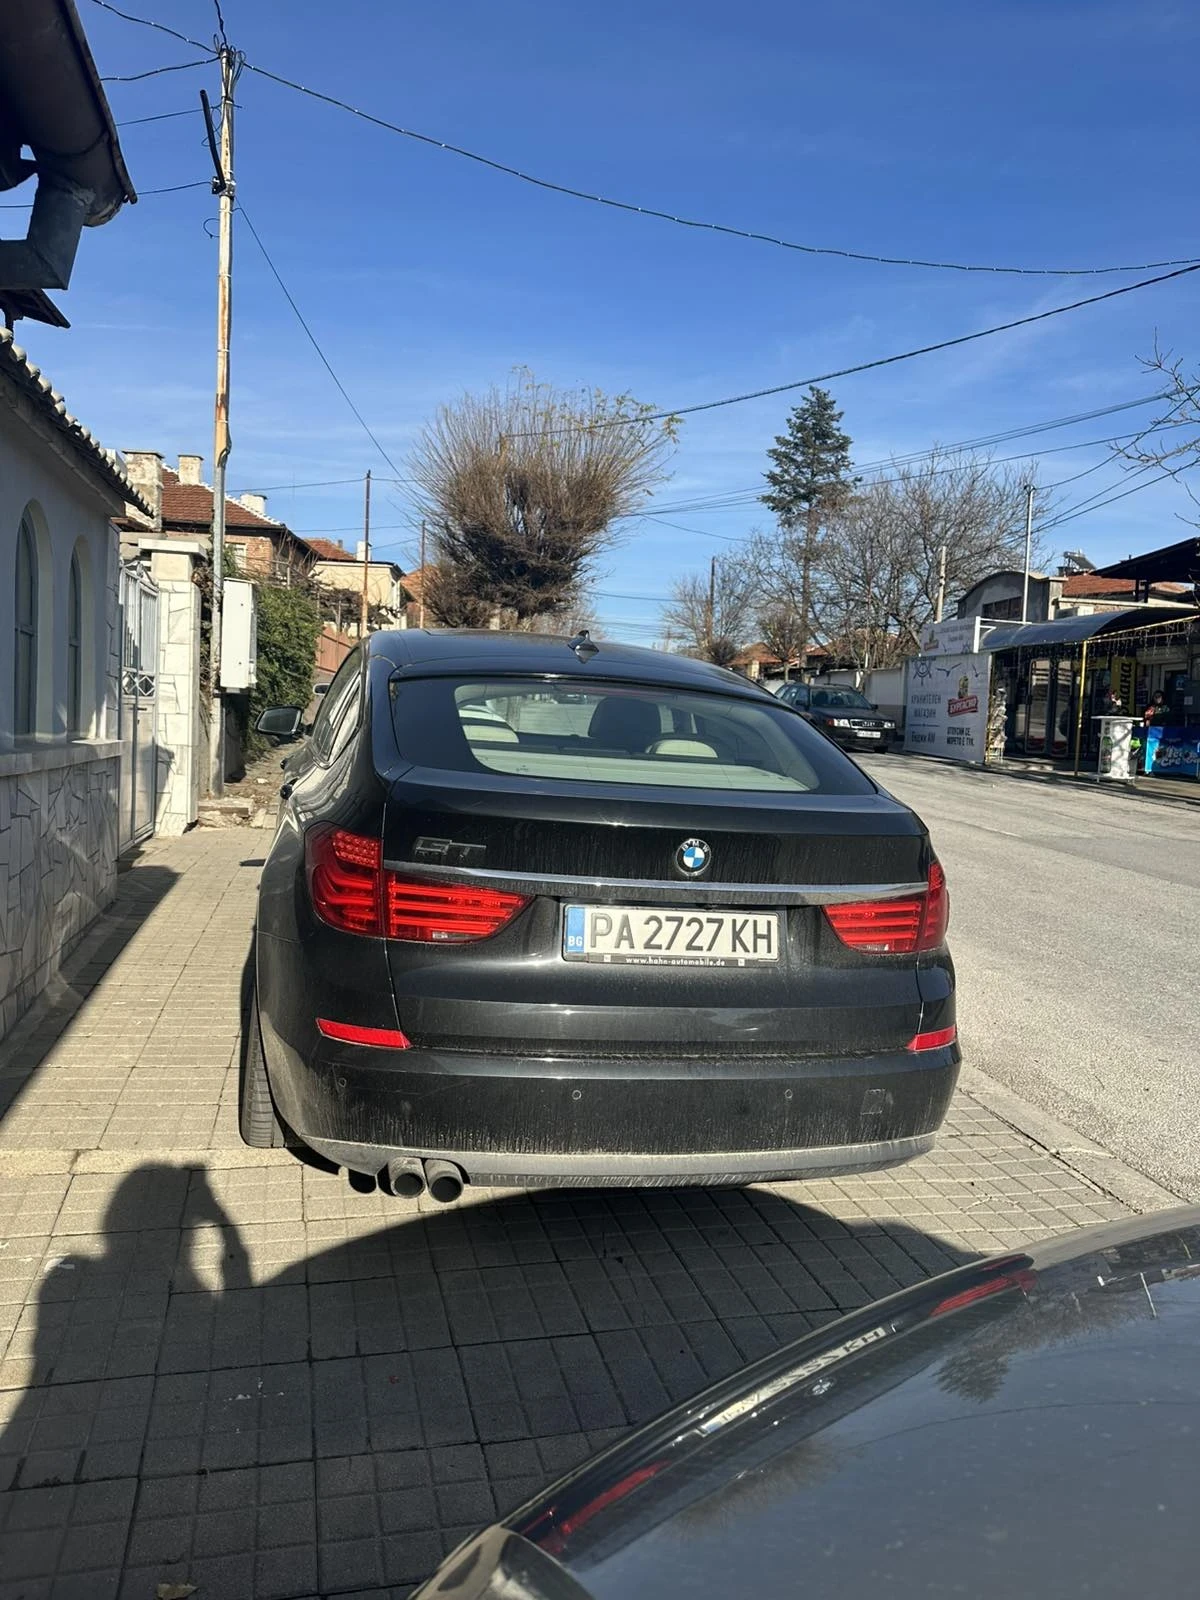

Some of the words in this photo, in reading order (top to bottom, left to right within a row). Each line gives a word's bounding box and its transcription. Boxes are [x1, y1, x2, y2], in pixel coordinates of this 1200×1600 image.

[681, 839, 710, 853] BMW
[590, 912, 635, 949] PA
[643, 915, 724, 952] 2727
[731, 918, 772, 954] KH
[568, 936, 583, 947] BG
